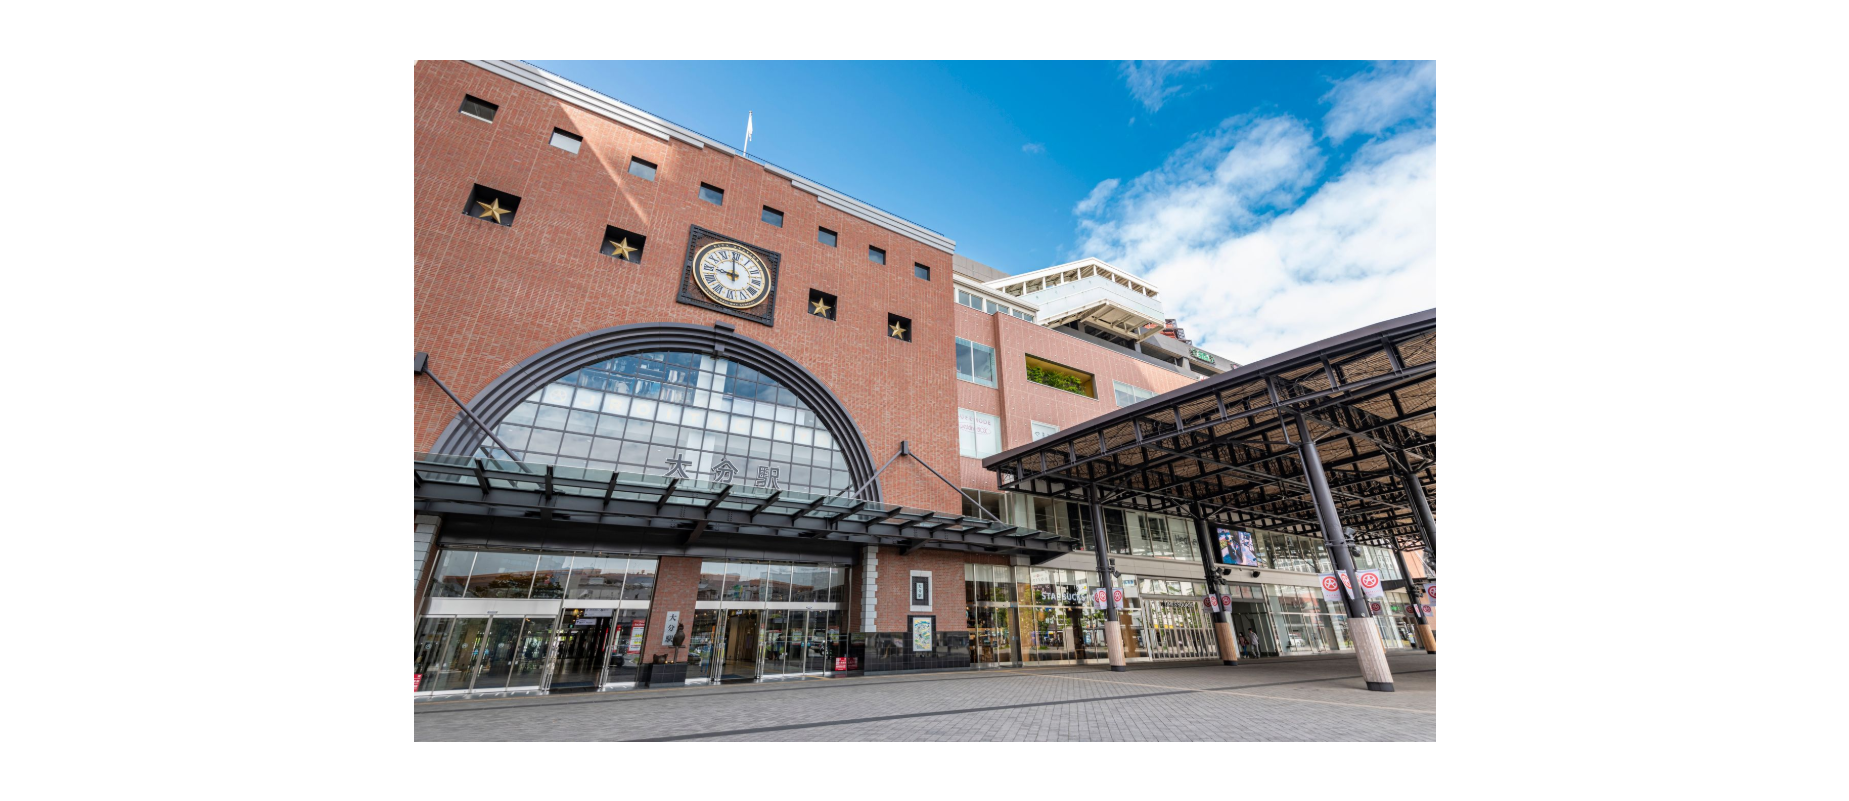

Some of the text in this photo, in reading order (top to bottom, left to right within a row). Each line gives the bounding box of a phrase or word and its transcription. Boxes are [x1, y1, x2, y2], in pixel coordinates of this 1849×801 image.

[709, 255, 719, 264] X
[718, 251, 728, 259] XI
[732, 252, 740, 261] XII
[740, 291, 747, 300] V
[664, 453, 781, 489] 大分駅
[1042, 592, 1086, 602] STARBUCKS
